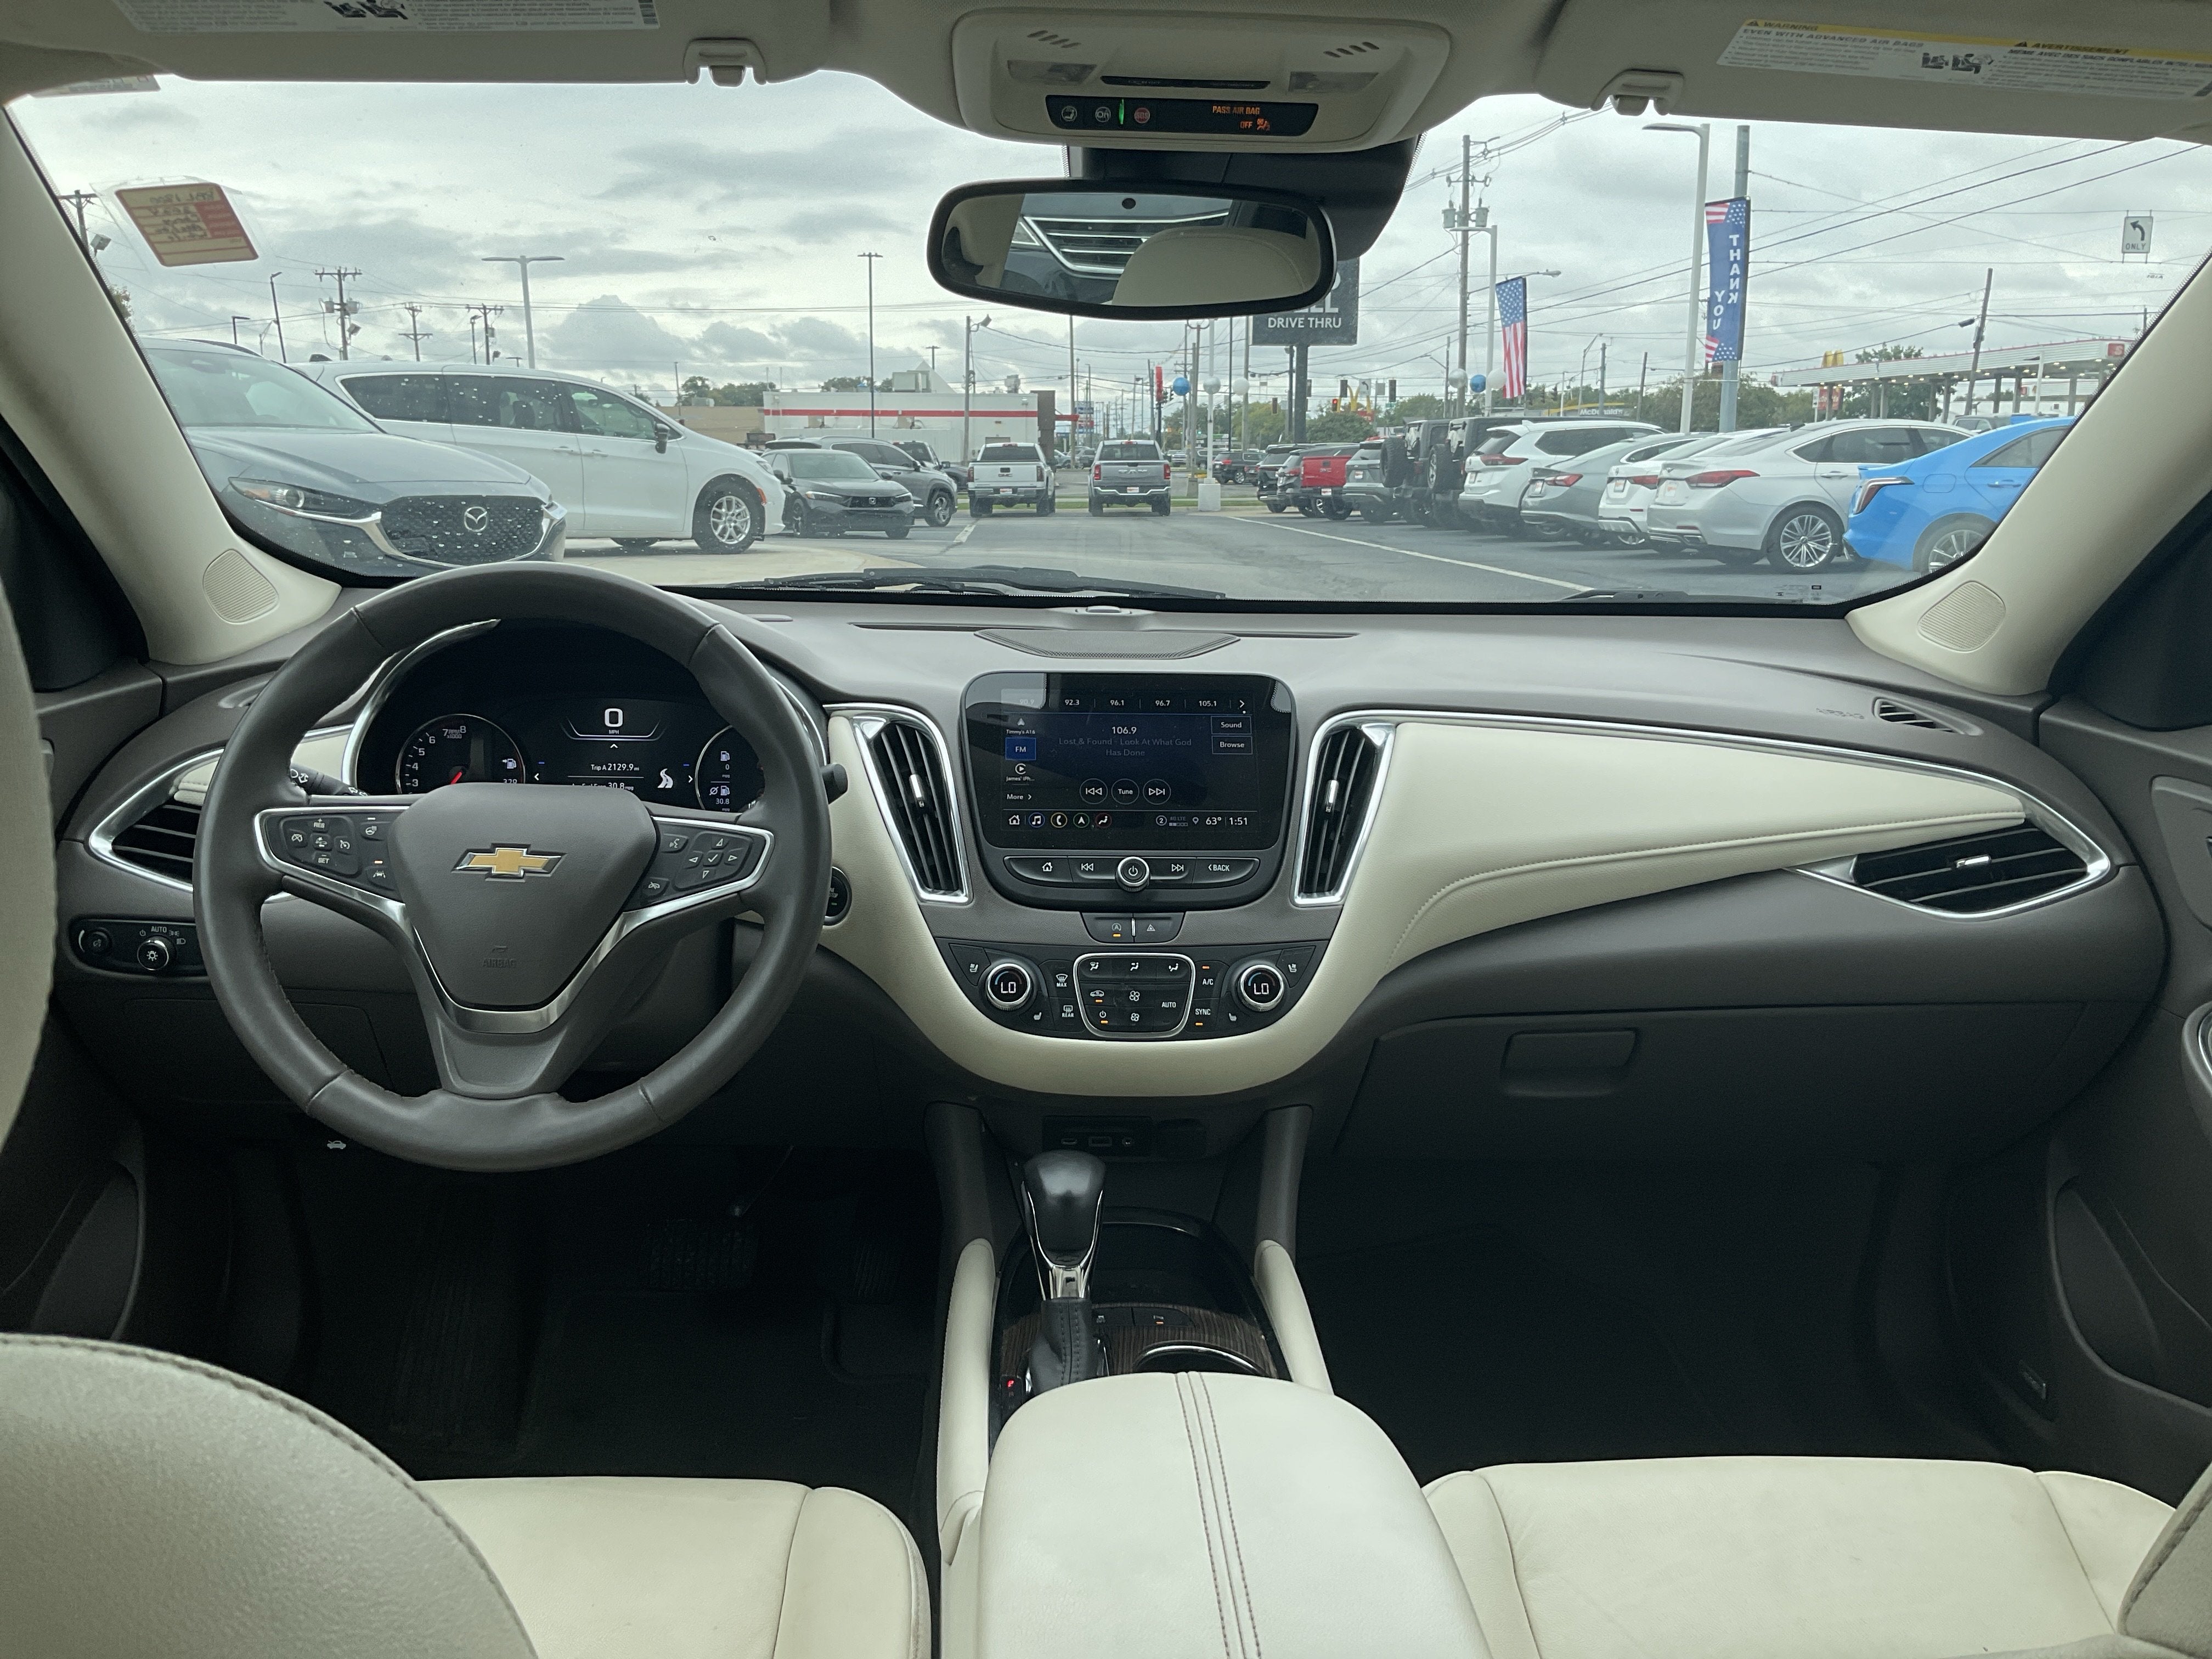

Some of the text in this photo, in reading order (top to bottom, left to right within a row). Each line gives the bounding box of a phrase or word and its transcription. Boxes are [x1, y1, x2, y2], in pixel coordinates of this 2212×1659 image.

[1764, 22, 1818, 31] WARNING
[1806, 34, 1866, 42] ADVANCED
[1268, 318, 1341, 328] DRIVE THRU
[604, 708, 623, 727] 0
[1111, 726, 1137, 735] 106.9
[607, 763, 634, 771] 2129.9
[1229, 817, 1248, 826] 1:51
[482, 958, 517, 968] AIRBAG
